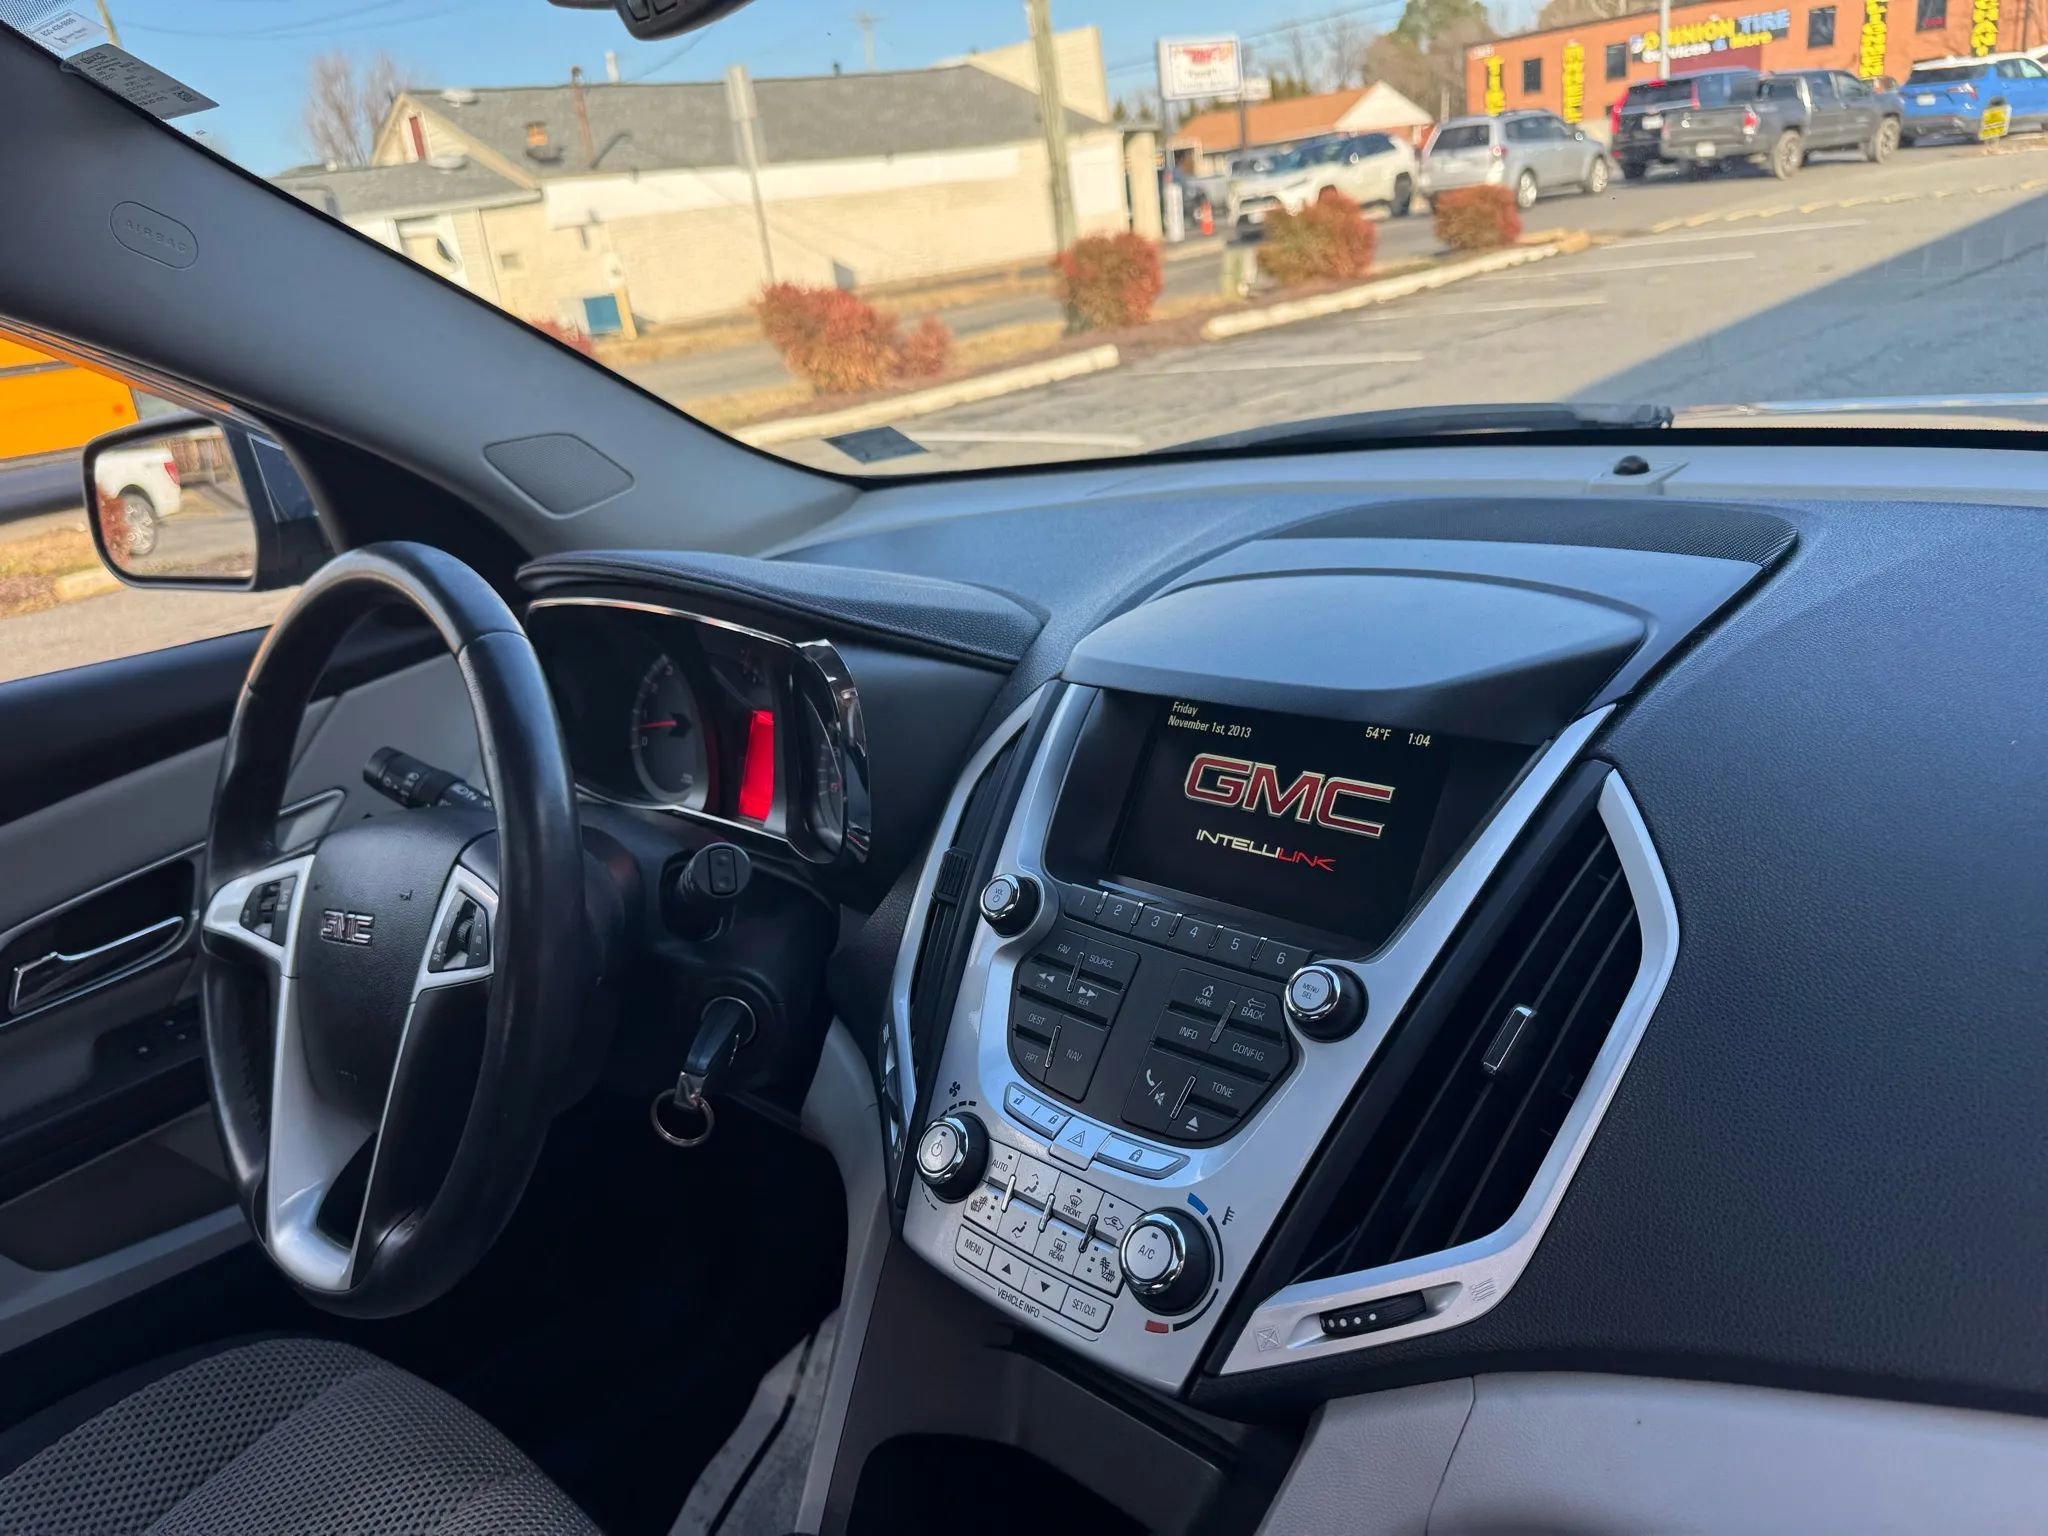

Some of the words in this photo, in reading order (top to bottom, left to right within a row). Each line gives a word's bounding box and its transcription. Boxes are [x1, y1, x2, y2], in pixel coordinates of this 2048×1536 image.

[1738, 9, 1790, 33] TIRE
[1172, 701, 1199, 716] Friday
[1167, 714, 1209, 732] November
[1227, 724, 1252, 739] 2013
[1365, 726, 1392, 741] 54°F
[1407, 733, 1431, 747] 1:04
[1184, 753, 1396, 839] GMC
[1196, 829, 1336, 872] INTELLILINK
[1113, 904, 1123, 916] 2
[1151, 915, 1161, 928] 3
[1189, 926, 1199, 938] 4
[1057, 943, 1071, 954] FAV
[1230, 937, 1241, 950] 5
[1088, 953, 1115, 969] SOURCE
[1276, 952, 1287, 965] 6
[1303, 982, 1321, 994] MENU
[1195, 996, 1213, 1008] HOME
[1028, 1013, 1047, 1026] DEST
[1240, 1007, 1265, 1022] BACK
[1178, 1026, 1199, 1040] INFO
[1024, 1052, 1039, 1064] RPT
[1066, 1049, 1083, 1063] NAV
[1232, 1042, 1265, 1062] CONFIG
[1211, 1081, 1234, 1098] TONE
[991, 1160, 1009, 1173] AUTO
[1062, 1203, 1082, 1219] FRONT
[964, 1239, 985, 1257] MENU
[1137, 1244, 1156, 1261] A/C
[1047, 1249, 1065, 1263] REAR
[997, 1287, 1024, 1312] VEHICLE
[1023, 1303, 1040, 1318] INFO
[1071, 1297, 1097, 1318] SET/CLR
